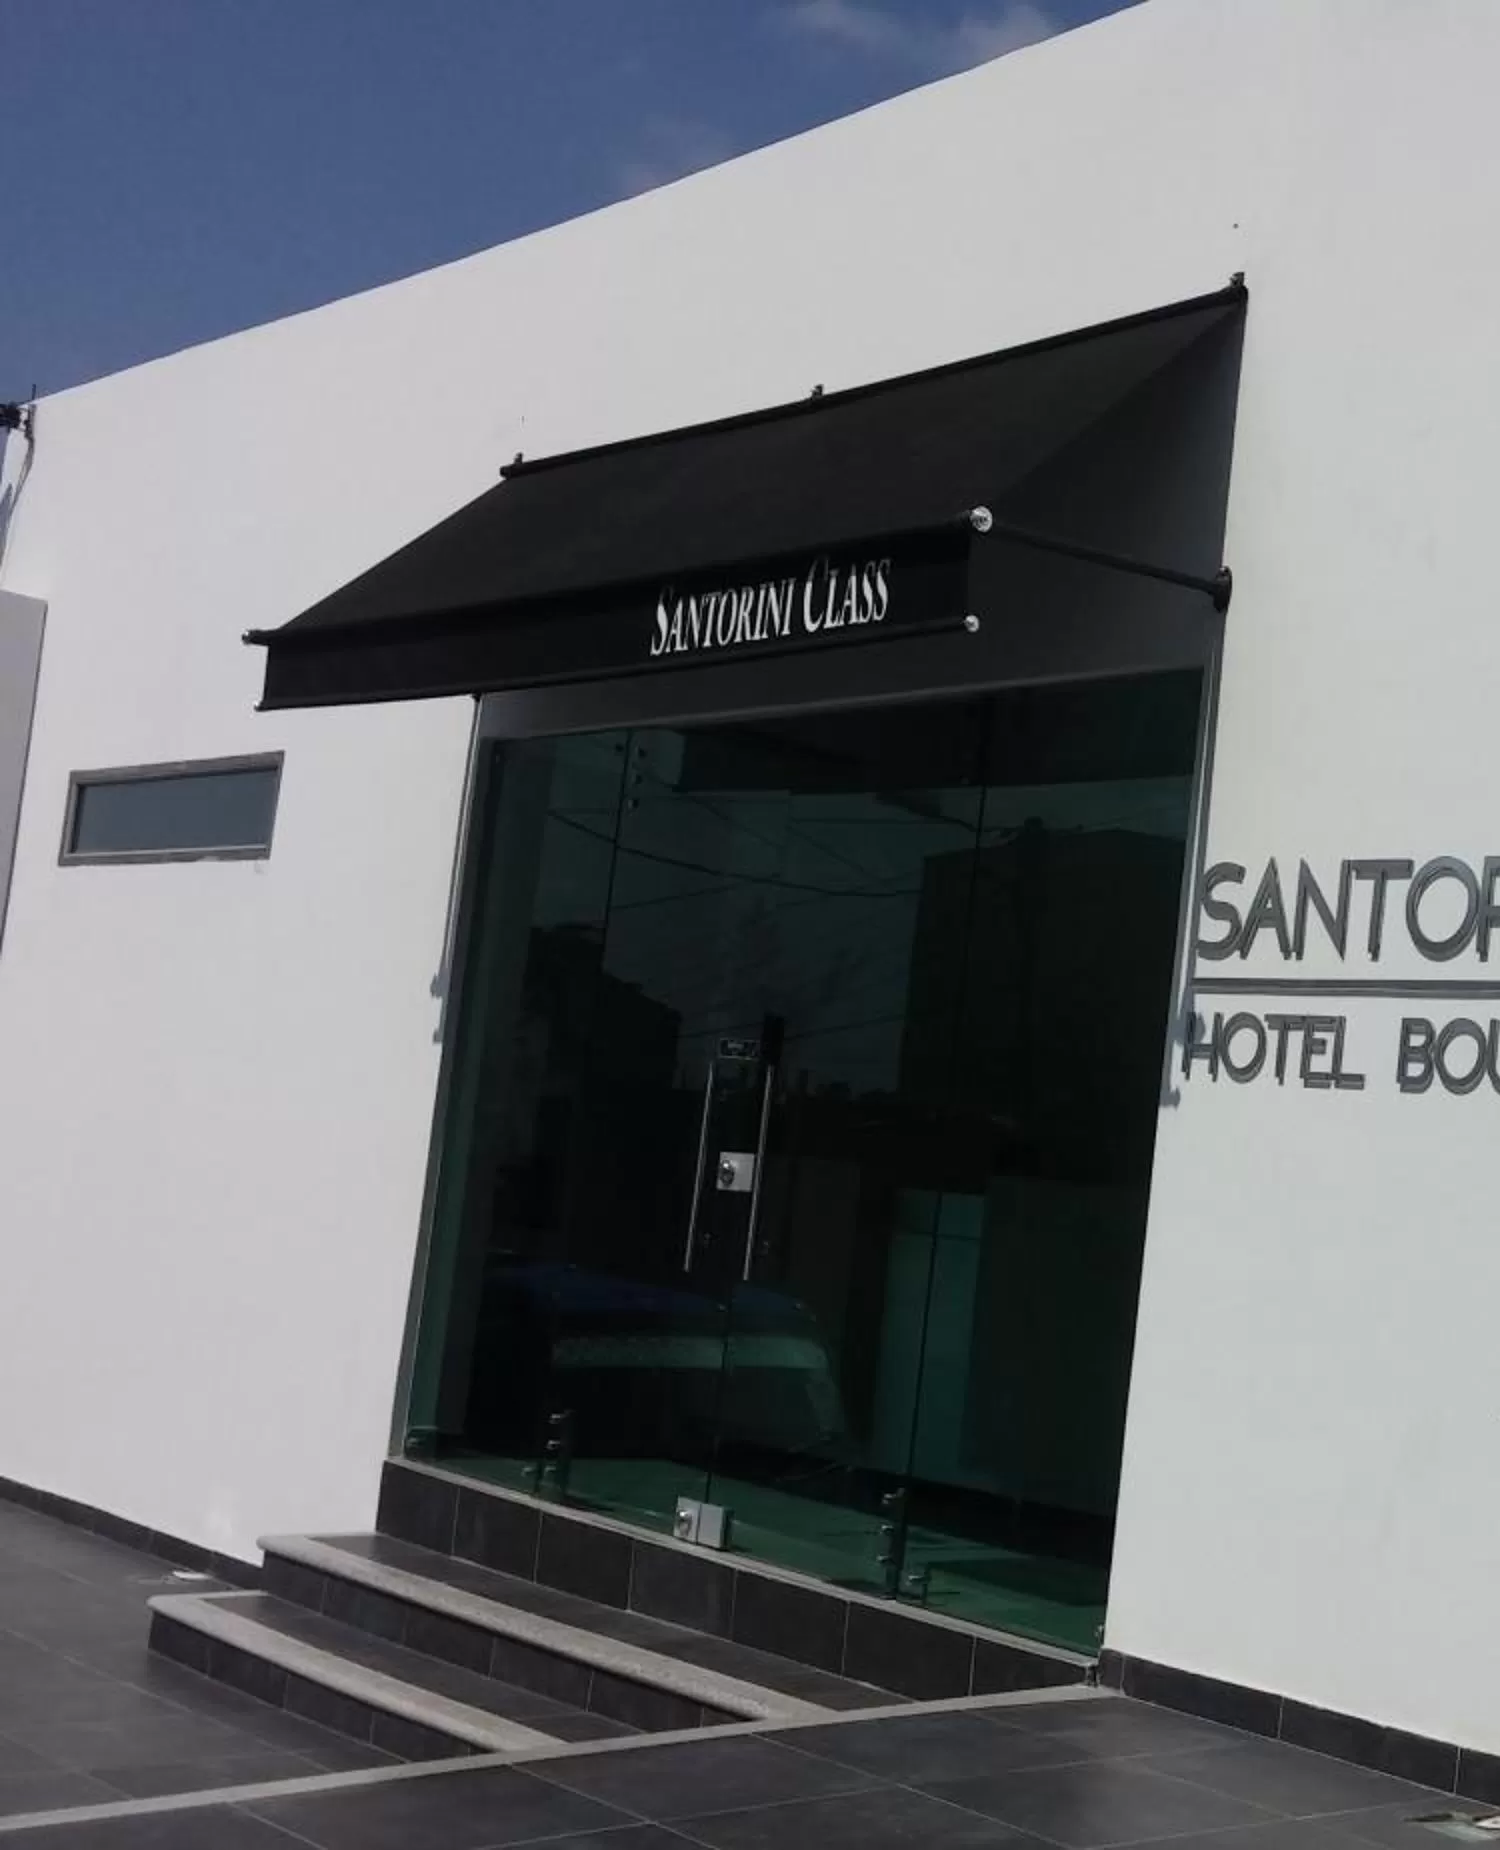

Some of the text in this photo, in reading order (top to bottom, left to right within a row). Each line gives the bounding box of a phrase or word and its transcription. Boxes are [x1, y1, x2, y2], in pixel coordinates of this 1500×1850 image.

[650, 556, 891, 656] SANTORINI CLASS
[1181, 1011, 1366, 1091] HOTEL
